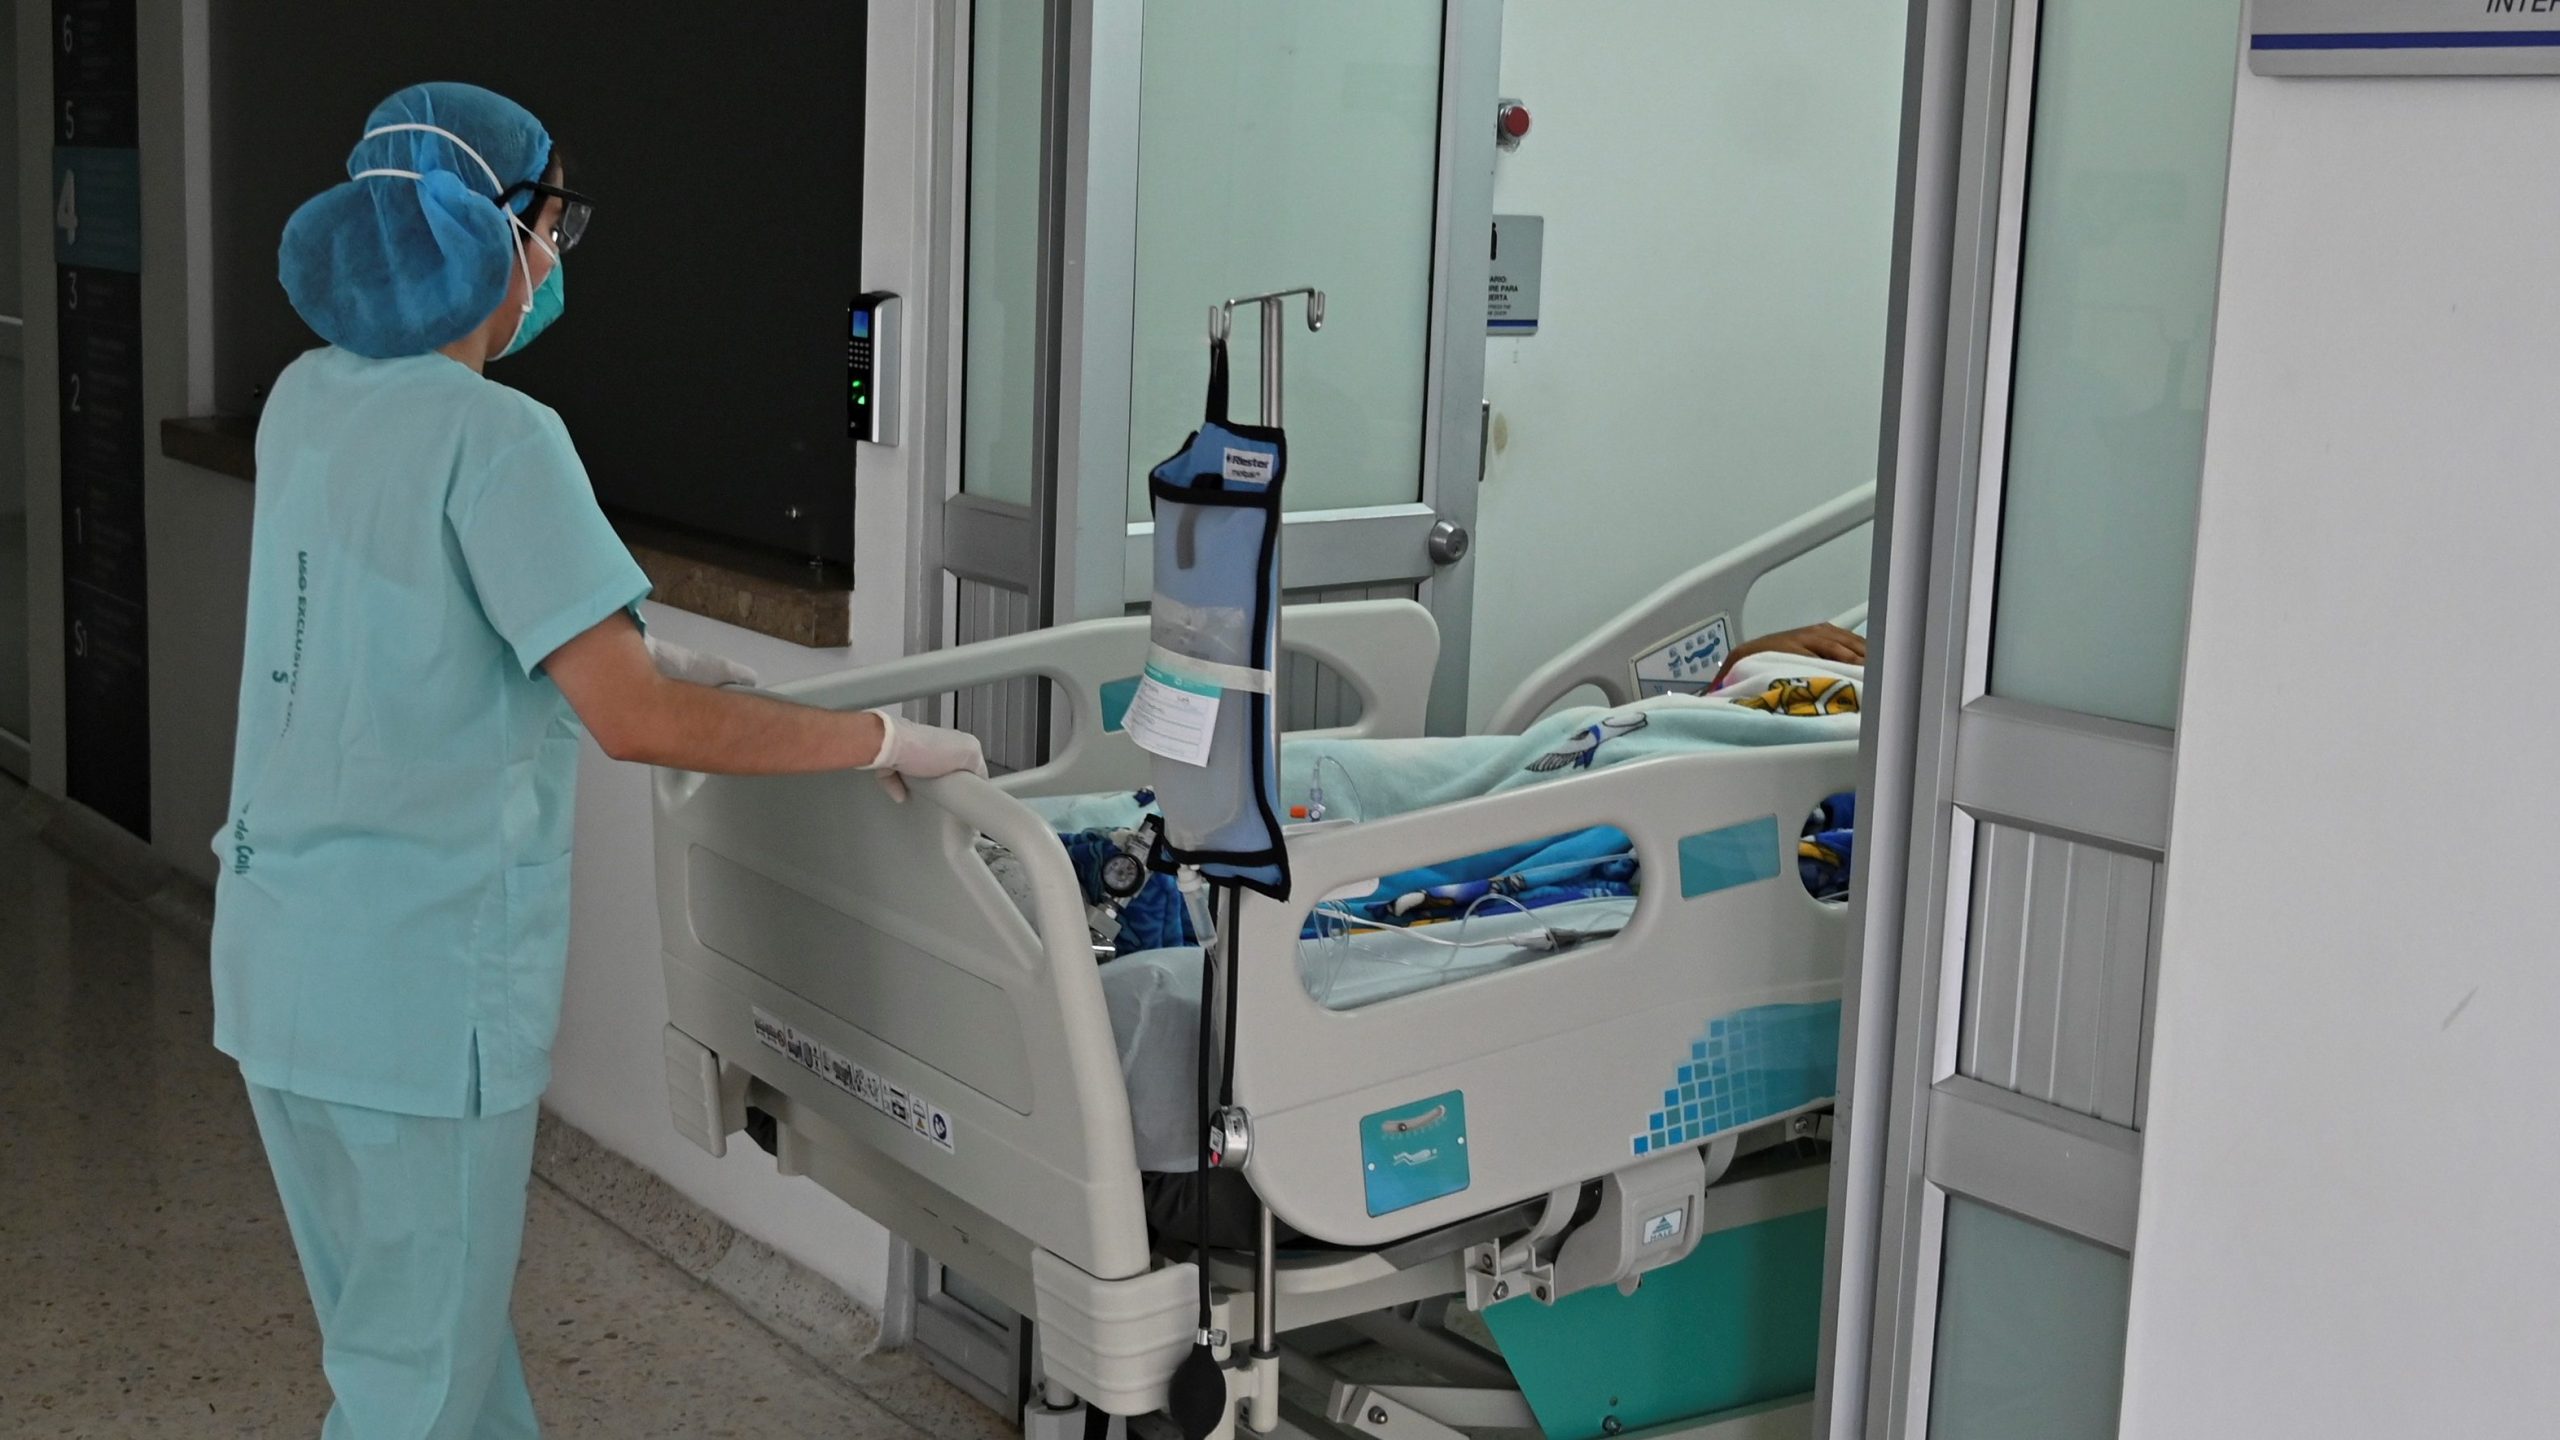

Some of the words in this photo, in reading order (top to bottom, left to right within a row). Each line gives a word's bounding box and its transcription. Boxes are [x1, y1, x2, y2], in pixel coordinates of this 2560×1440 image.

[62, 13, 74, 54] 6
[64, 99, 75, 140] 5
[56, 168, 79, 246] 4
[68, 272, 78, 311] 3
[70, 372, 80, 413] 2
[1231, 455, 1269, 469] Riester
[75, 507, 82, 544] 1
[298, 550, 308, 591] USO
[290, 595, 307, 695] EXCLUSIVO
[271, 670, 290, 684] S
